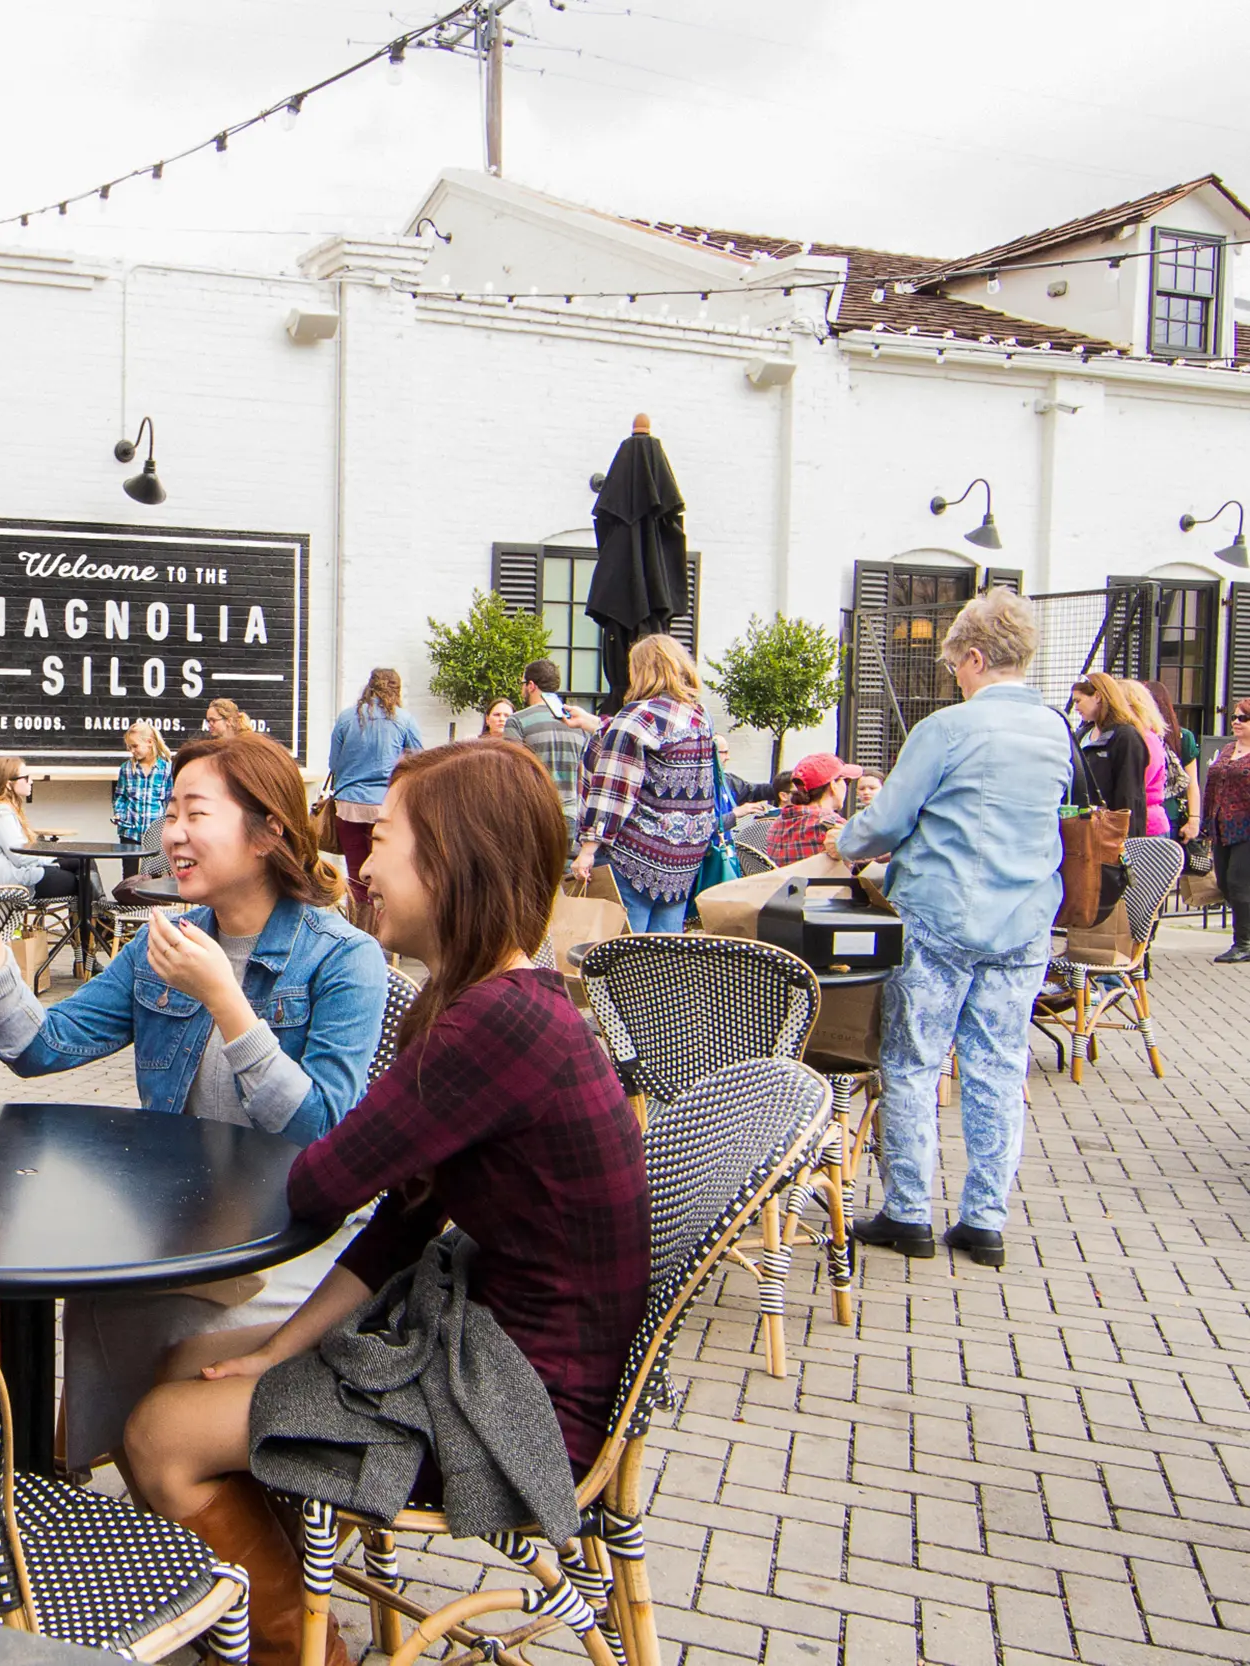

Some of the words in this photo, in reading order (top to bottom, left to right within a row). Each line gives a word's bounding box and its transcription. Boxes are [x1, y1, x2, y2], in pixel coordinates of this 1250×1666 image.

[17, 551, 159, 582] Welcome
[166, 565, 187, 583] TO
[195, 567, 228, 585] THE
[41, 655, 204, 699] SILOS
[14, 715, 66, 731] GOODS.
[84, 716, 130, 731] BAKED
